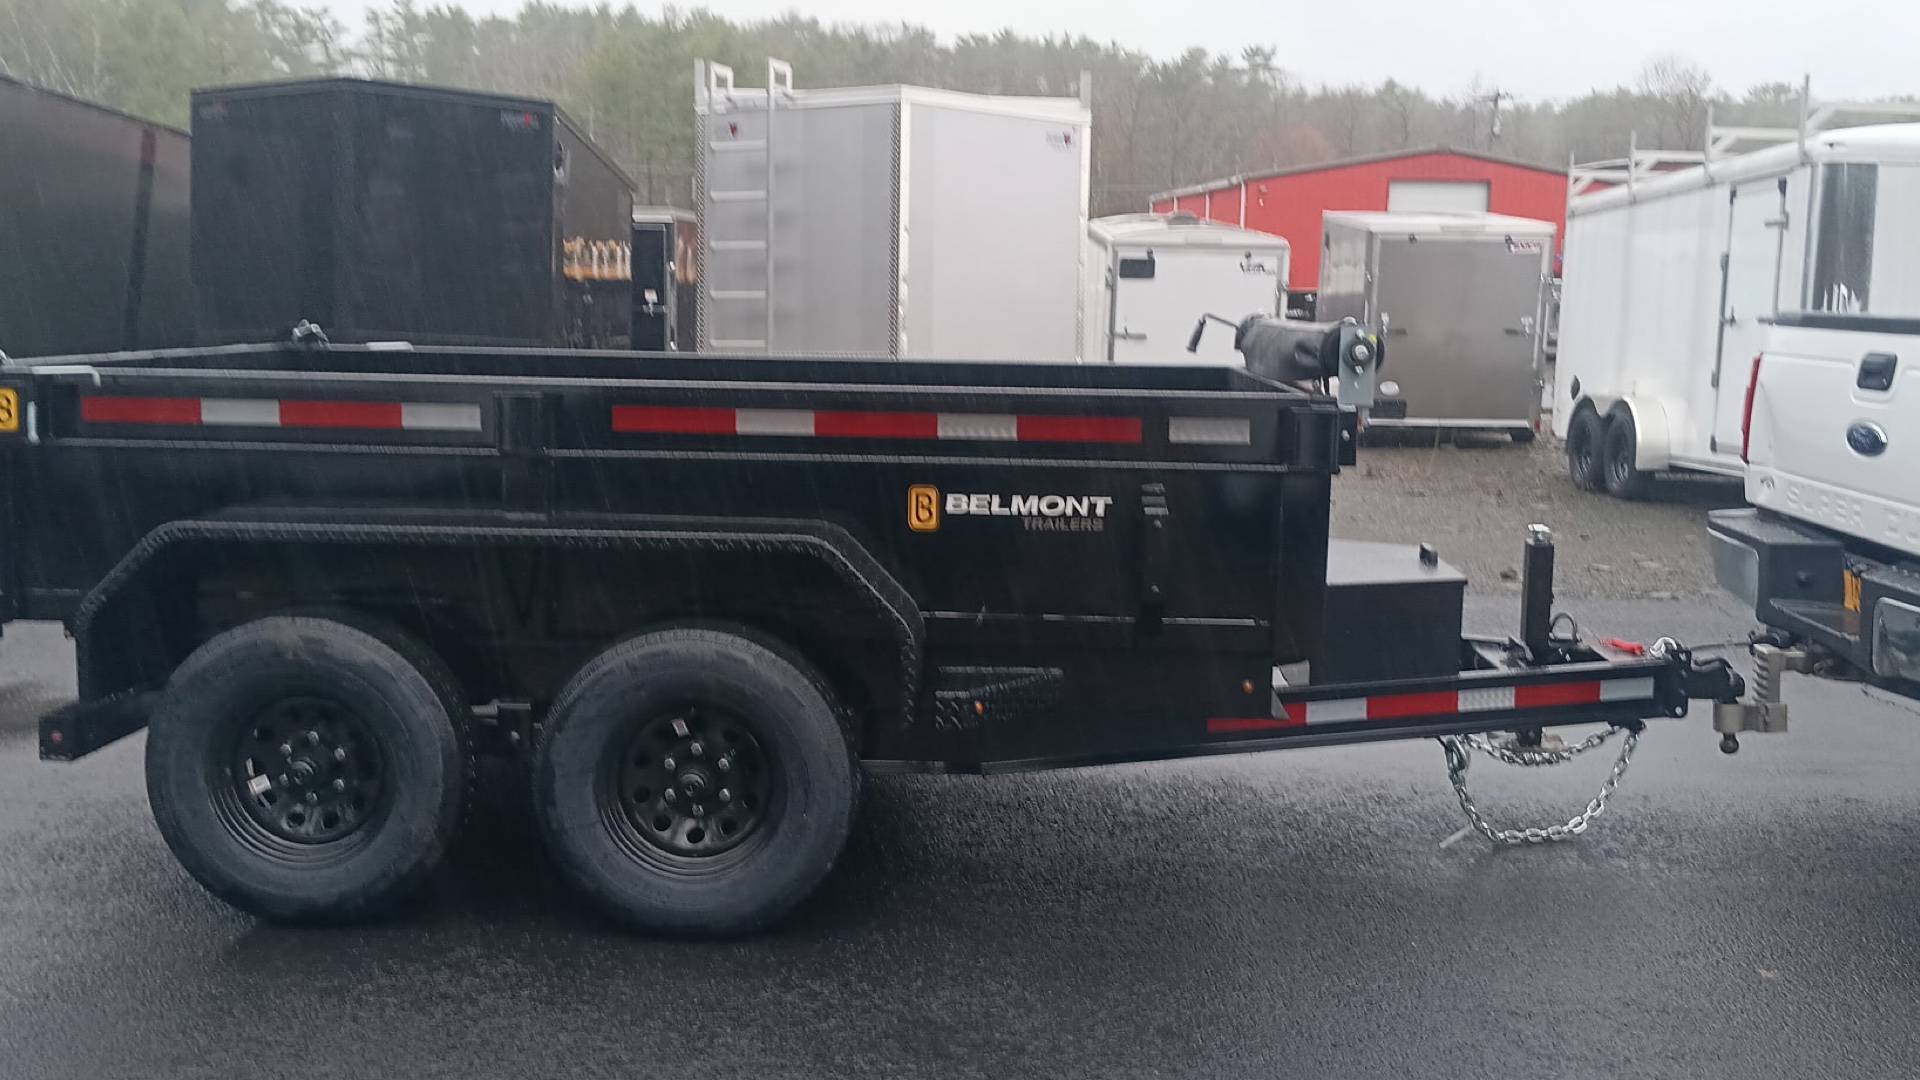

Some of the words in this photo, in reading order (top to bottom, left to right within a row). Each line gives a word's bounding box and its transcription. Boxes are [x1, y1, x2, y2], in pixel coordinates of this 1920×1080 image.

[946, 493, 1113, 517] BELMONT
[1786, 485, 1865, 530] SUPER
[1022, 517, 1103, 531] TRAILERS
